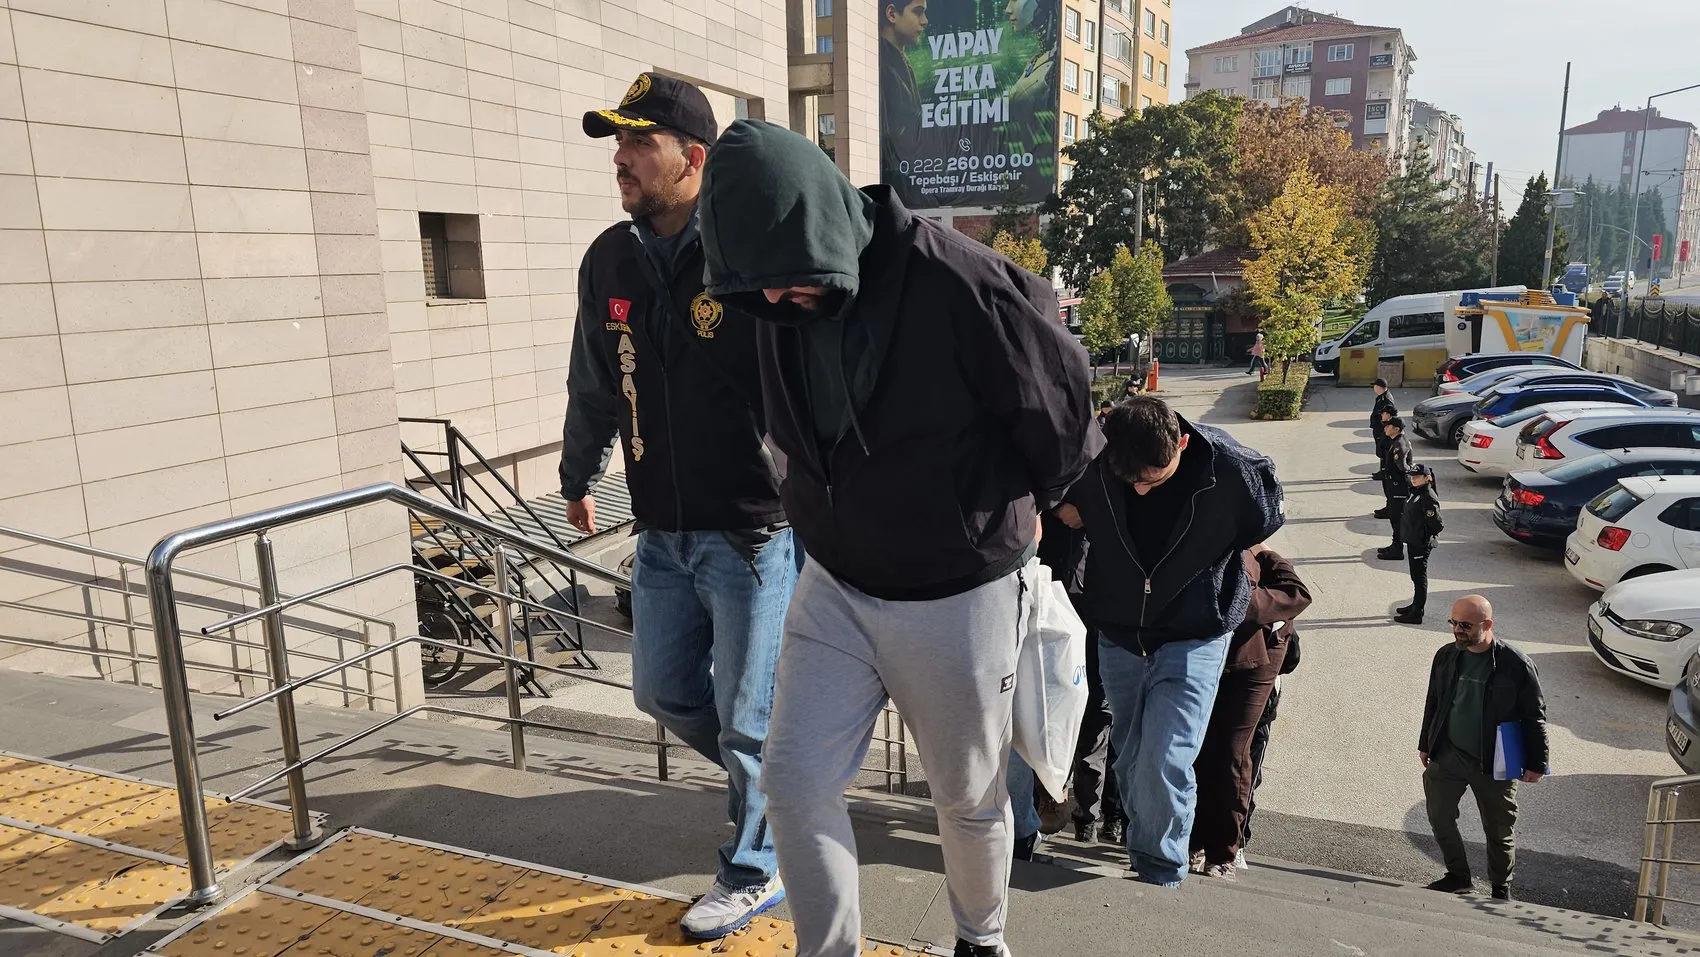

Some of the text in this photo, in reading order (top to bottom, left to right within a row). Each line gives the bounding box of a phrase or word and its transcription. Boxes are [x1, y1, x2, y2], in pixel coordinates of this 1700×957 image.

[928, 28, 1003, 60] YAPAY
[934, 64, 996, 94] ZEKA
[921, 91, 1010, 128] EĞİTİMİ
[899, 152, 1034, 173] 0 222 260 00 00
[909, 174, 959, 187] Tepebaşı
[921, 185, 939, 195] Opera
[617, 334, 644, 462] ASAYİŞ
